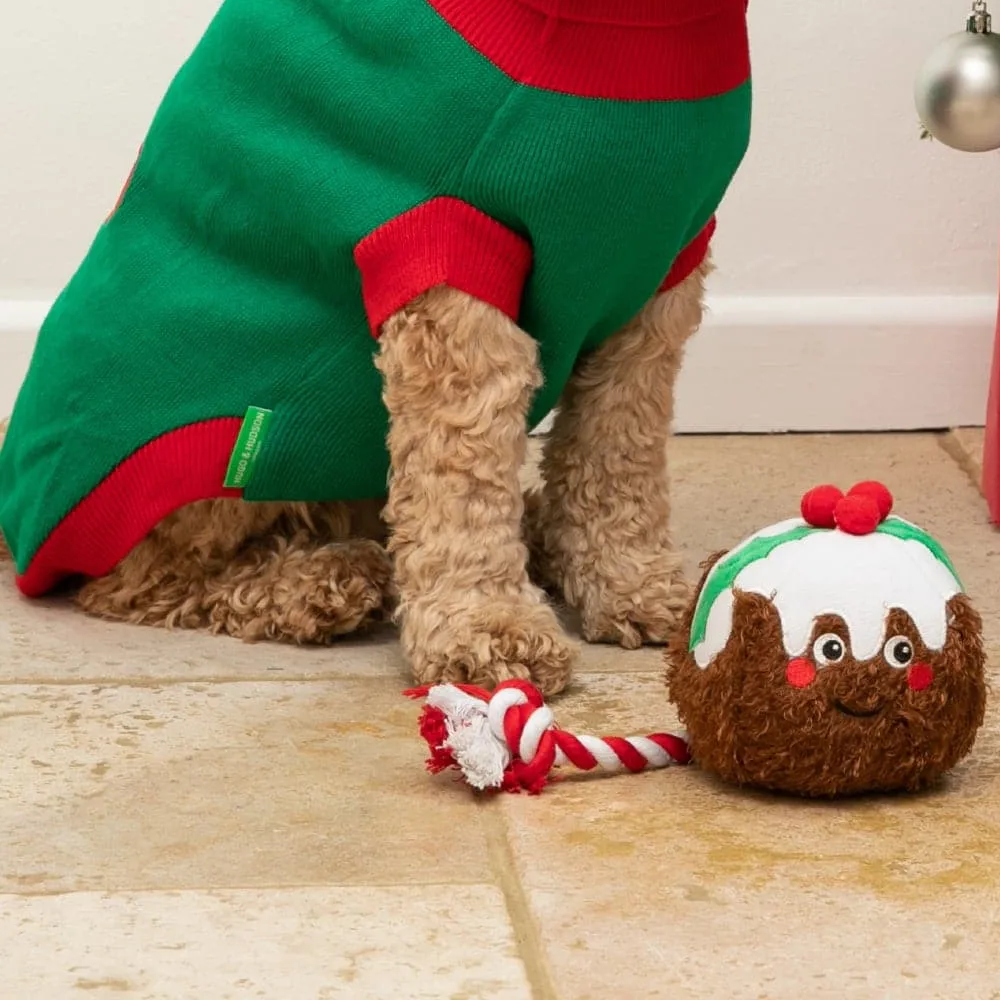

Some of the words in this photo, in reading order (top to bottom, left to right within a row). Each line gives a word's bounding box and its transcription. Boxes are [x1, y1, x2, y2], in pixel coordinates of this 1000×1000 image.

[245, 412, 265, 450] HUDSON
[242, 451, 250, 460] &
[234, 460, 247, 483] HUGO
